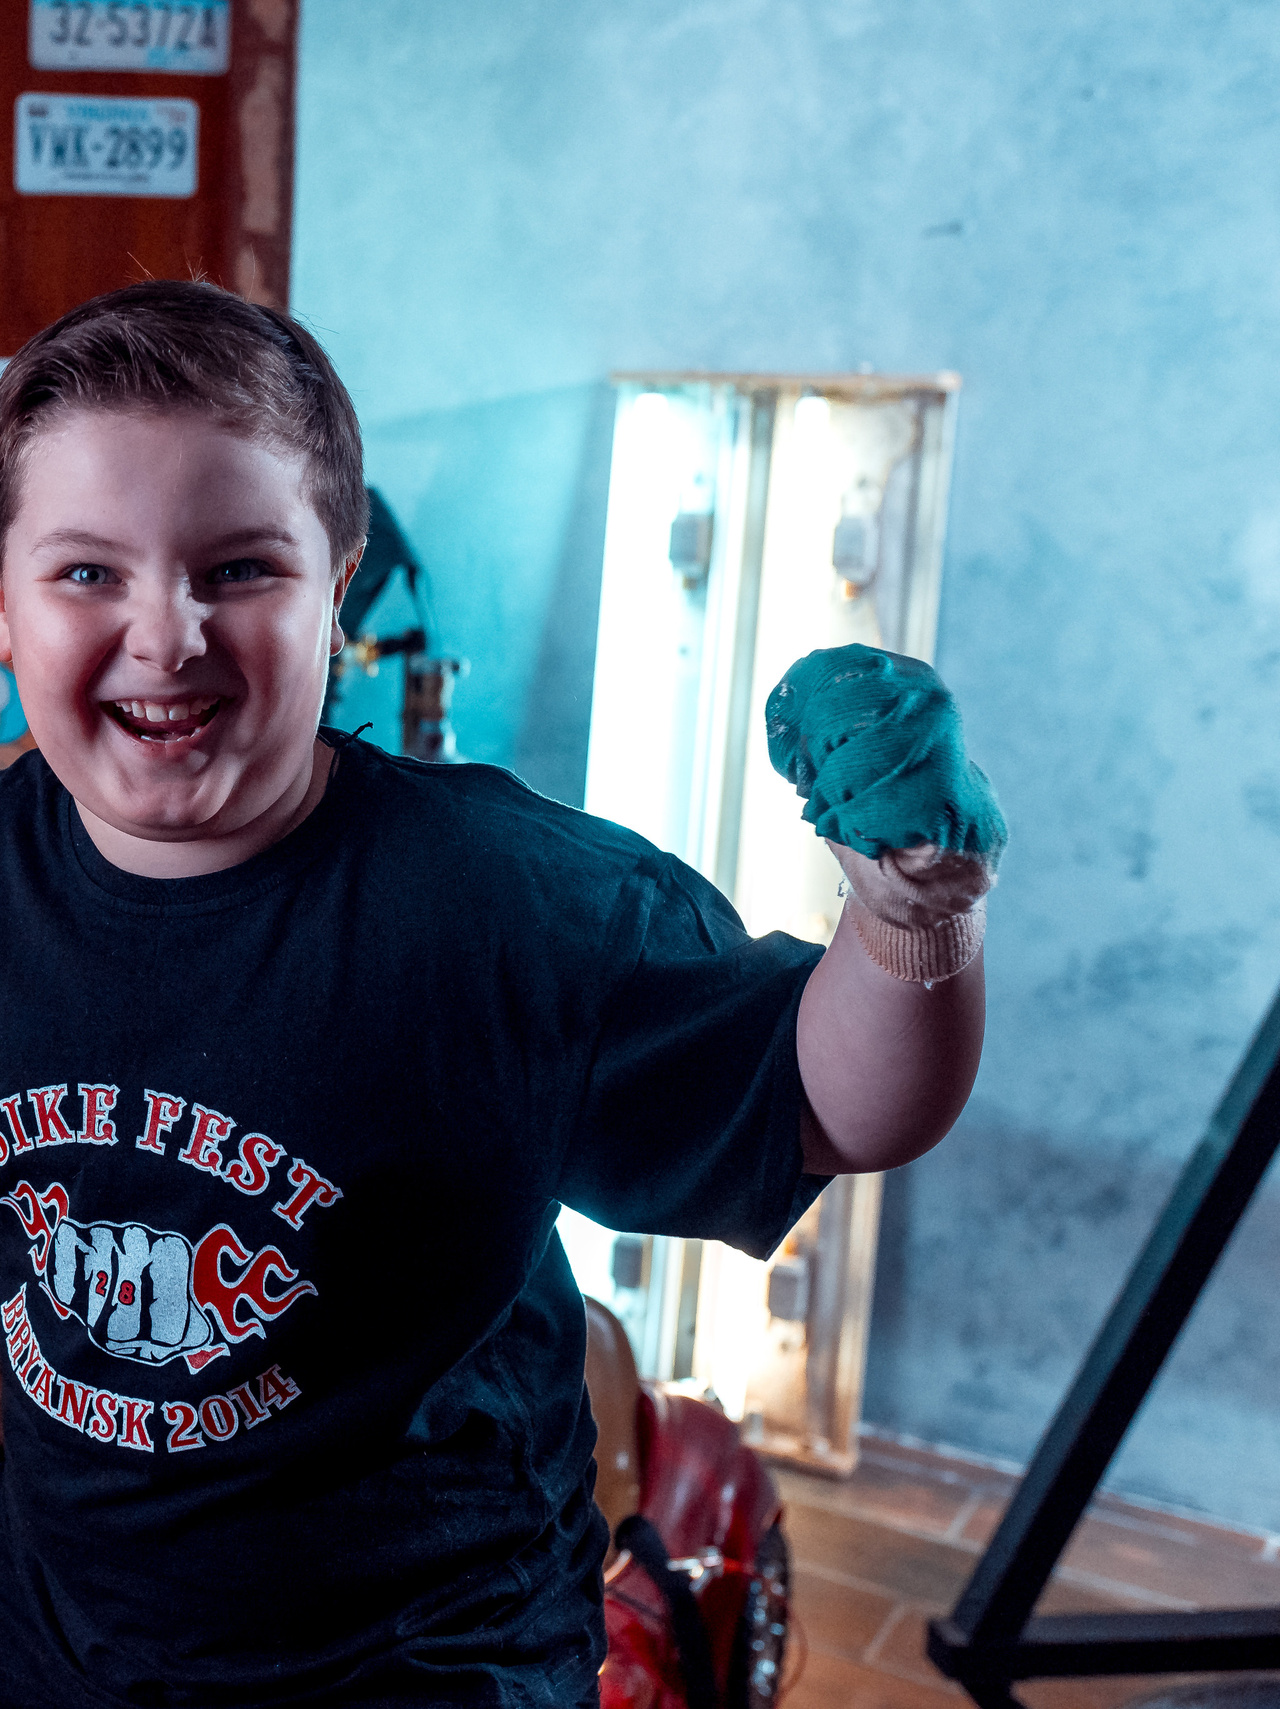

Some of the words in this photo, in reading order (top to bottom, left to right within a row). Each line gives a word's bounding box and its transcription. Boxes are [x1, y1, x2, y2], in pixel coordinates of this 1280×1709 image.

[135, 1089, 344, 1231] FEST
[0, 1283, 154, 1453] BRYANSK
[164, 1363, 302, 1453] 2014
